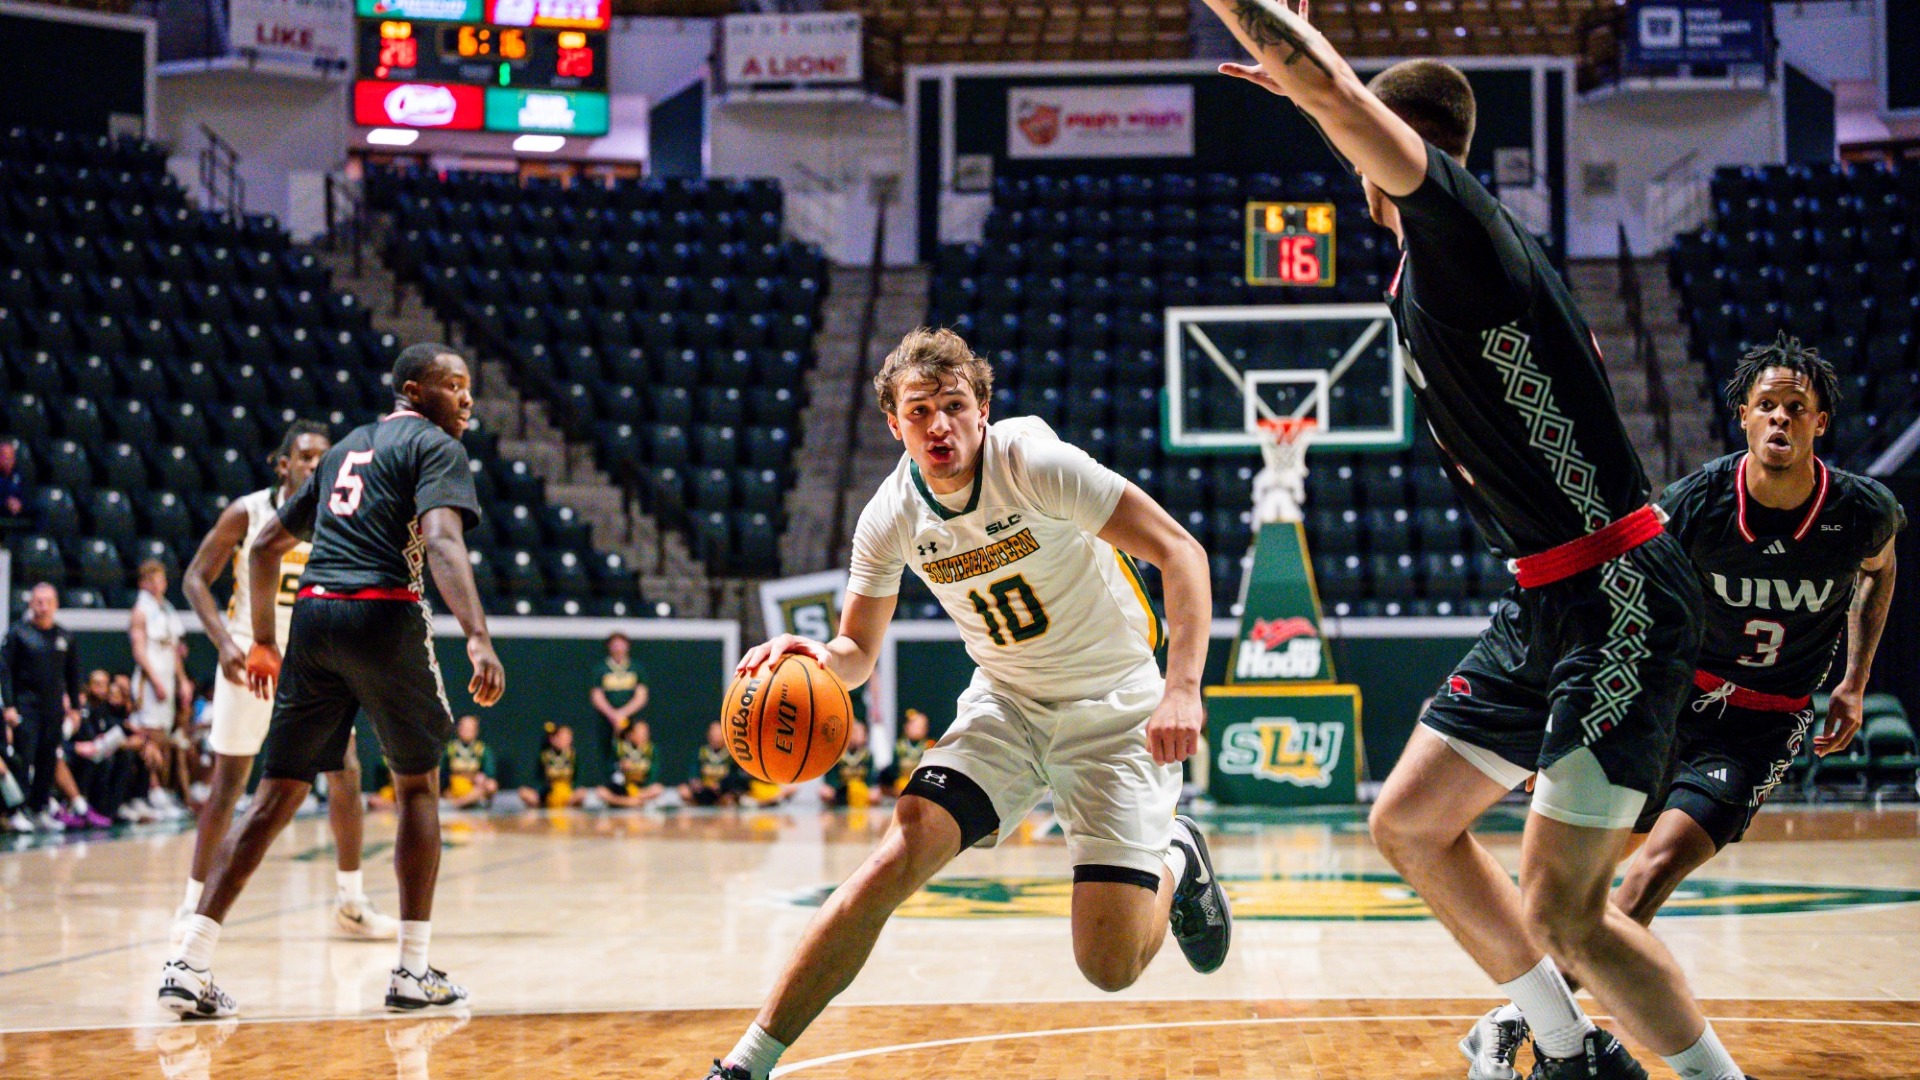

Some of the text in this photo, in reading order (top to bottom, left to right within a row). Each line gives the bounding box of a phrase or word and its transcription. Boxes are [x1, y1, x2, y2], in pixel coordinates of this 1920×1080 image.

[256, 23, 313, 51] LIKE
[742, 56, 762, 77] A
[1279, 235, 1320, 284] 16
[329, 449, 374, 517] 5
[985, 513, 1022, 536] SLC
[1820, 523, 1844, 532] SLC
[922, 527, 1041, 585] SOUTHEASTERN
[967, 571, 1052, 647] 10
[1710, 571, 1835, 614] UIW
[1735, 618, 1786, 668] 3
[732, 678, 763, 762] Wilson
